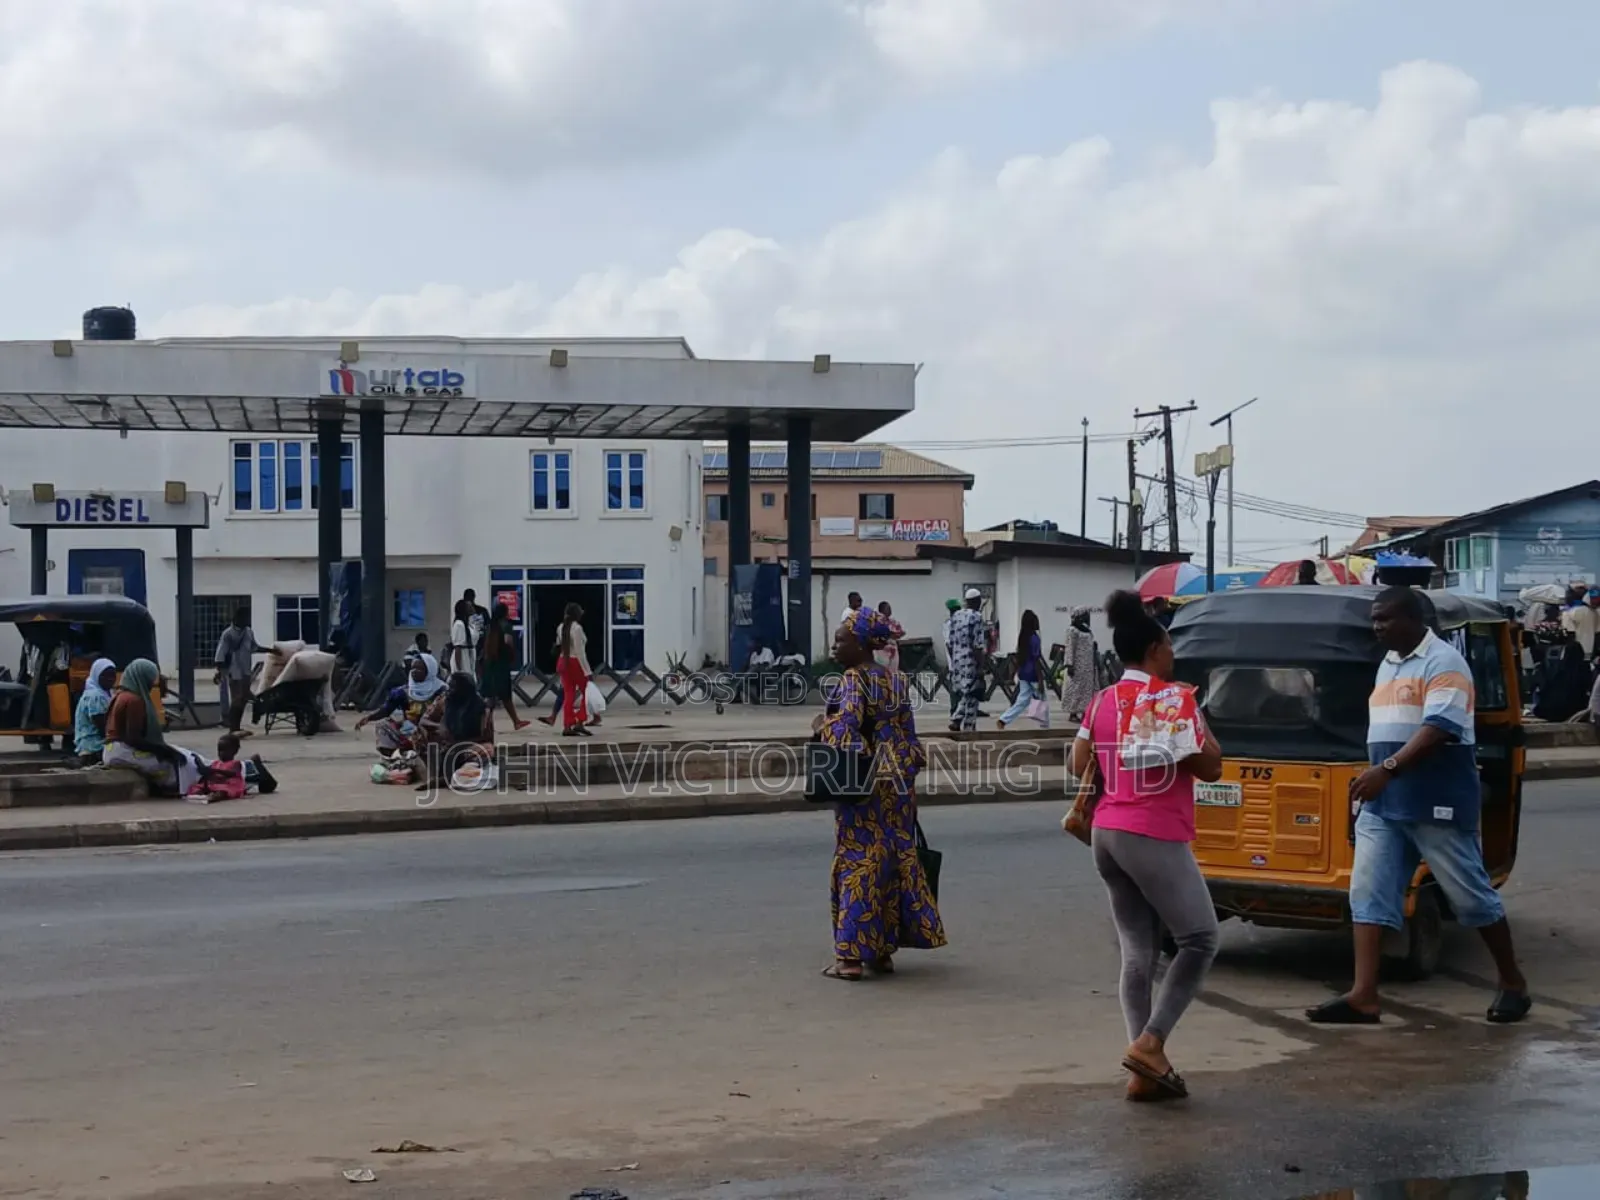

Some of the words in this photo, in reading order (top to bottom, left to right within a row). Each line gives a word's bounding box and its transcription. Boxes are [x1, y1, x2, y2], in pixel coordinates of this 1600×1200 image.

[56, 498, 150, 522] DIESEL
[894, 520, 950, 532] AutoCAD
[1240, 766, 1274, 780] TVS
